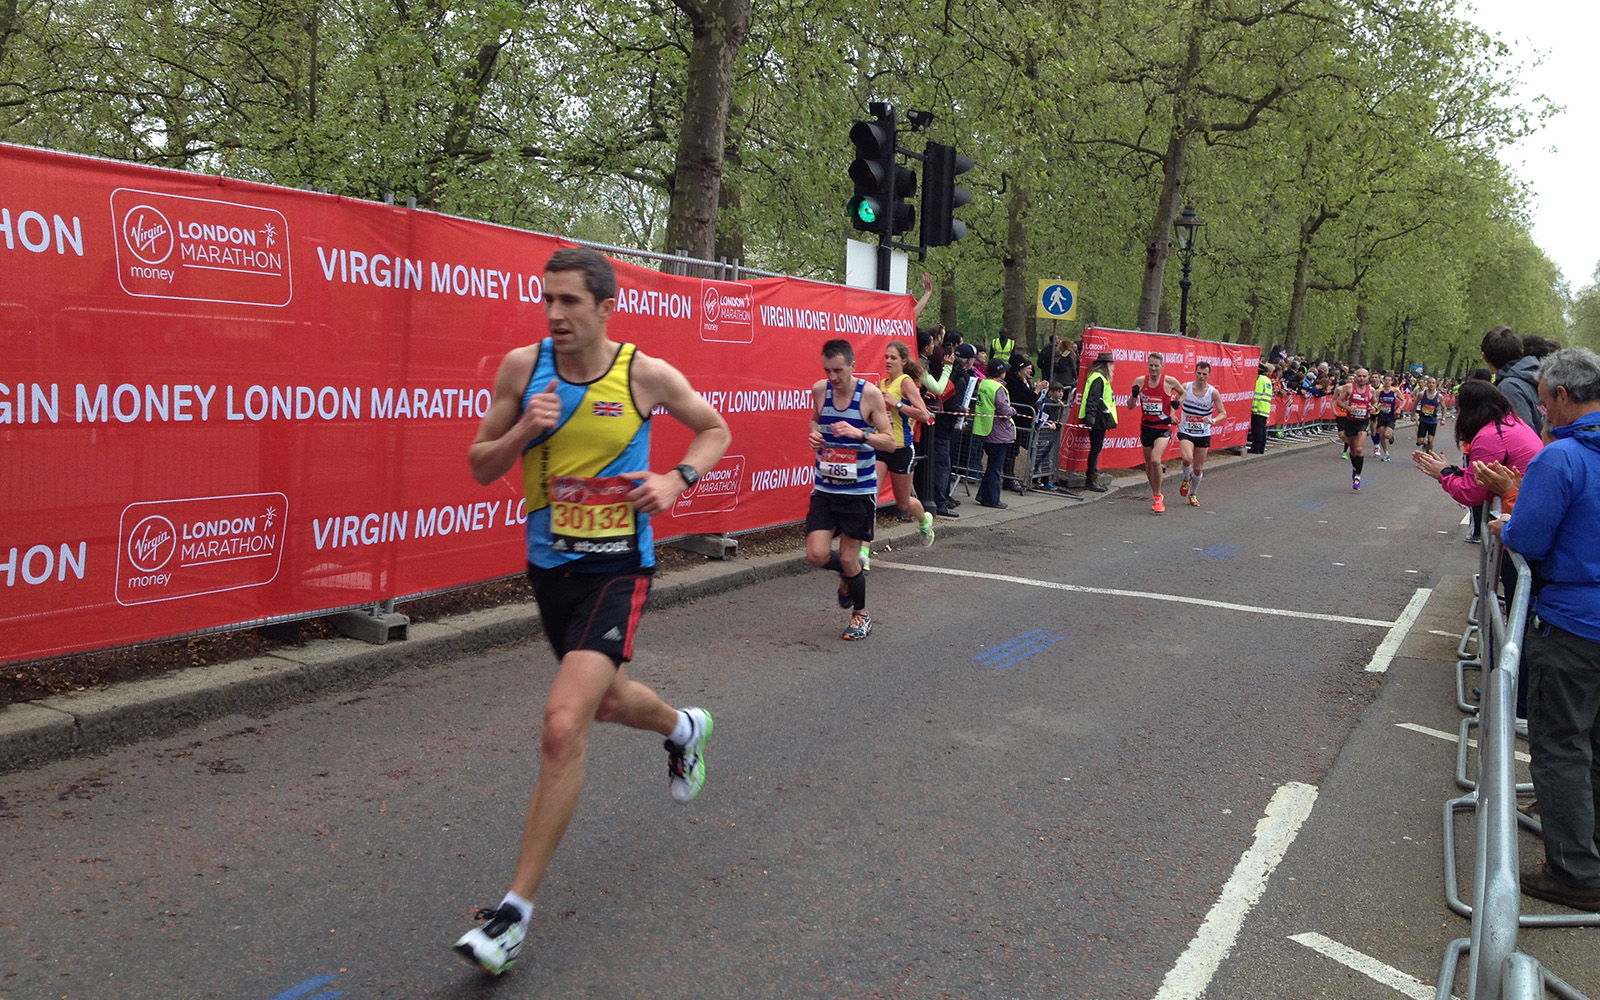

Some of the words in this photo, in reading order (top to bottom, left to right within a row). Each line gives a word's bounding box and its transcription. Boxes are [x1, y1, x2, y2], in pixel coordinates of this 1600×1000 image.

[131, 214, 167, 253] Virgin
[178, 221, 256, 246] LONDON
[181, 244, 282, 270] MARATHON
[131, 266, 175, 284] money
[317, 246, 423, 290] VIRGIN
[431, 262, 511, 300] MONEY
[518, 273, 545, 304] LO
[613, 287, 691, 319] ARATHON
[720, 295, 745, 308] LONDON
[721, 308, 751, 321] MARATHON
[760, 305, 794, 328] VIRGIN
[795, 309, 831, 331] MONEY
[833, 313, 872, 335] LONDON
[873, 318, 914, 336] MARATHON
[704, 323, 718, 332] money
[1128, 350, 1145, 362] MONEY
[75, 383, 217, 423] MONEY
[227, 385, 361, 420] LONDON
[370, 387, 493, 419] MARATHO
[728, 390, 775, 412] LONDON
[777, 390, 814, 410] MARAT
[1116, 437, 1138, 449] MONEY
[702, 470, 732, 482] LONDON
[751, 468, 790, 491] VIRGIN
[828, 464, 848, 477] 785
[698, 480, 738, 493] MARATHON
[182, 517, 256, 540] LONDON
[312, 510, 408, 550] VIRGIN
[415, 500, 500, 539] MONEY
[554, 504, 630, 531] 30132
[135, 524, 171, 562] Virgin
[180, 534, 276, 561] MARATHON
[128, 573, 172, 588] money
